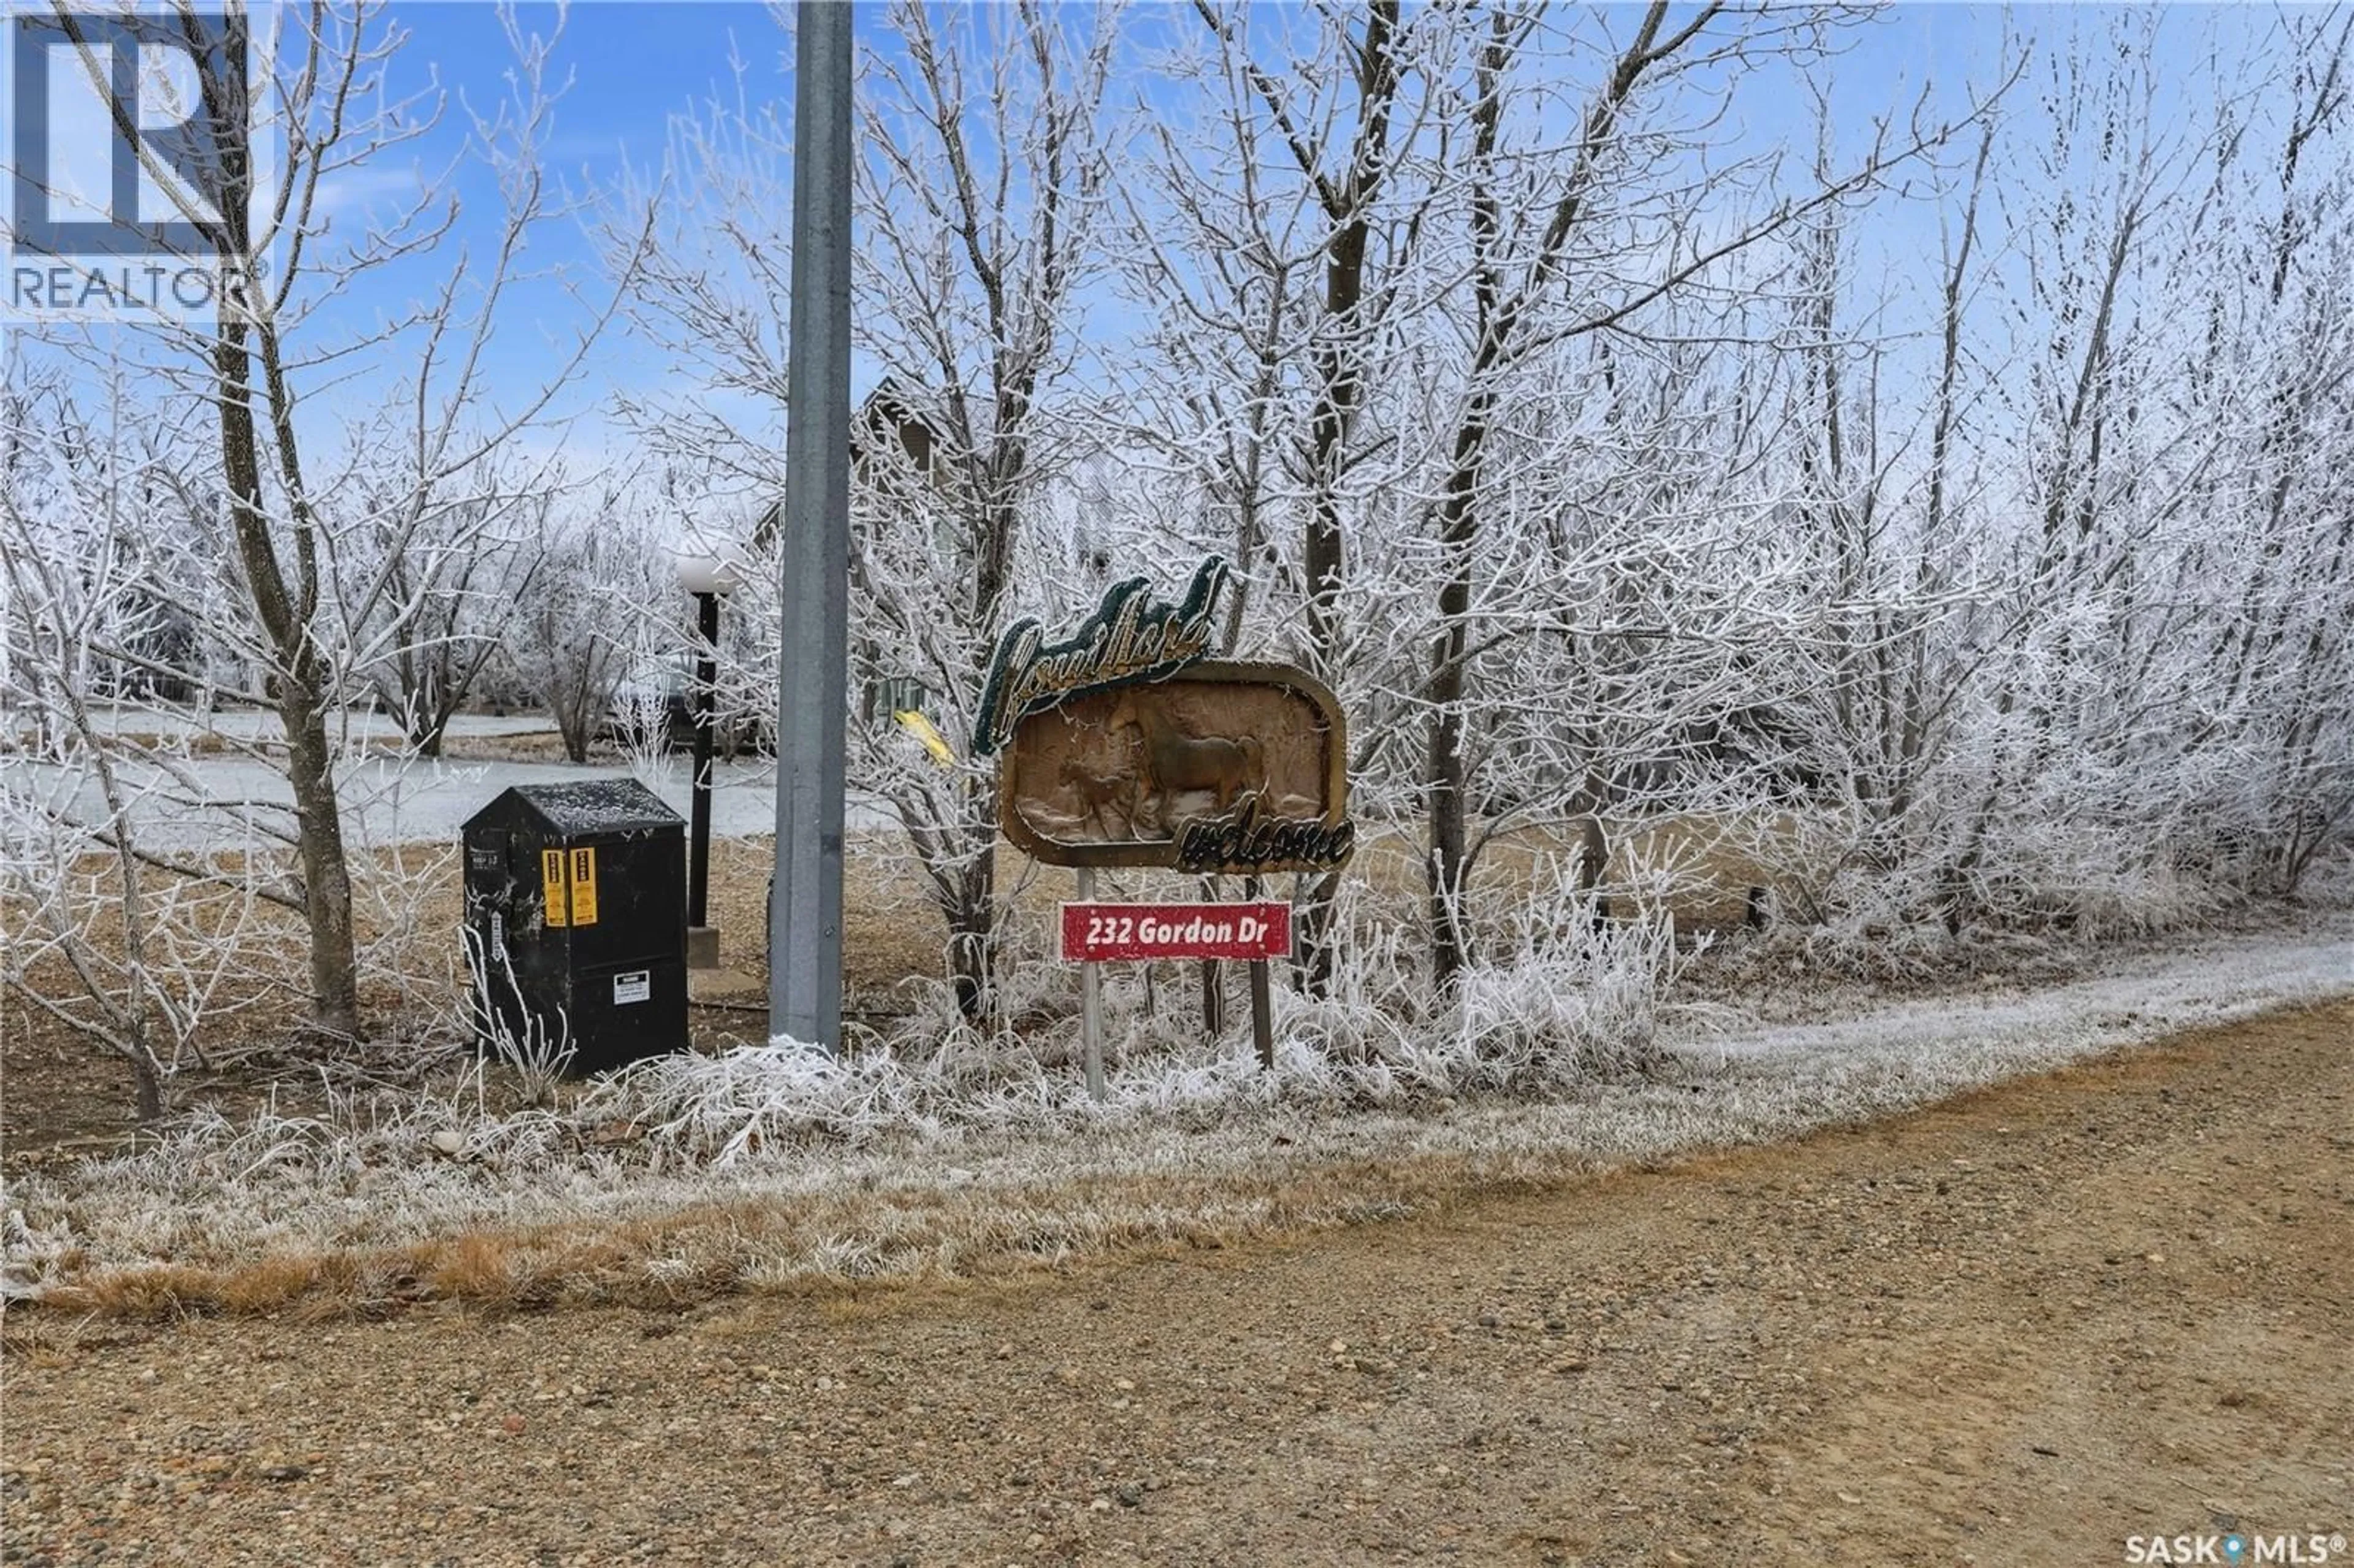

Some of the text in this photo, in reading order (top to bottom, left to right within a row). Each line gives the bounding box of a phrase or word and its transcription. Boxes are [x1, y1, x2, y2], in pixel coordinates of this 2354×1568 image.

[1086, 915, 1269, 945] 232 Gordon Dr
